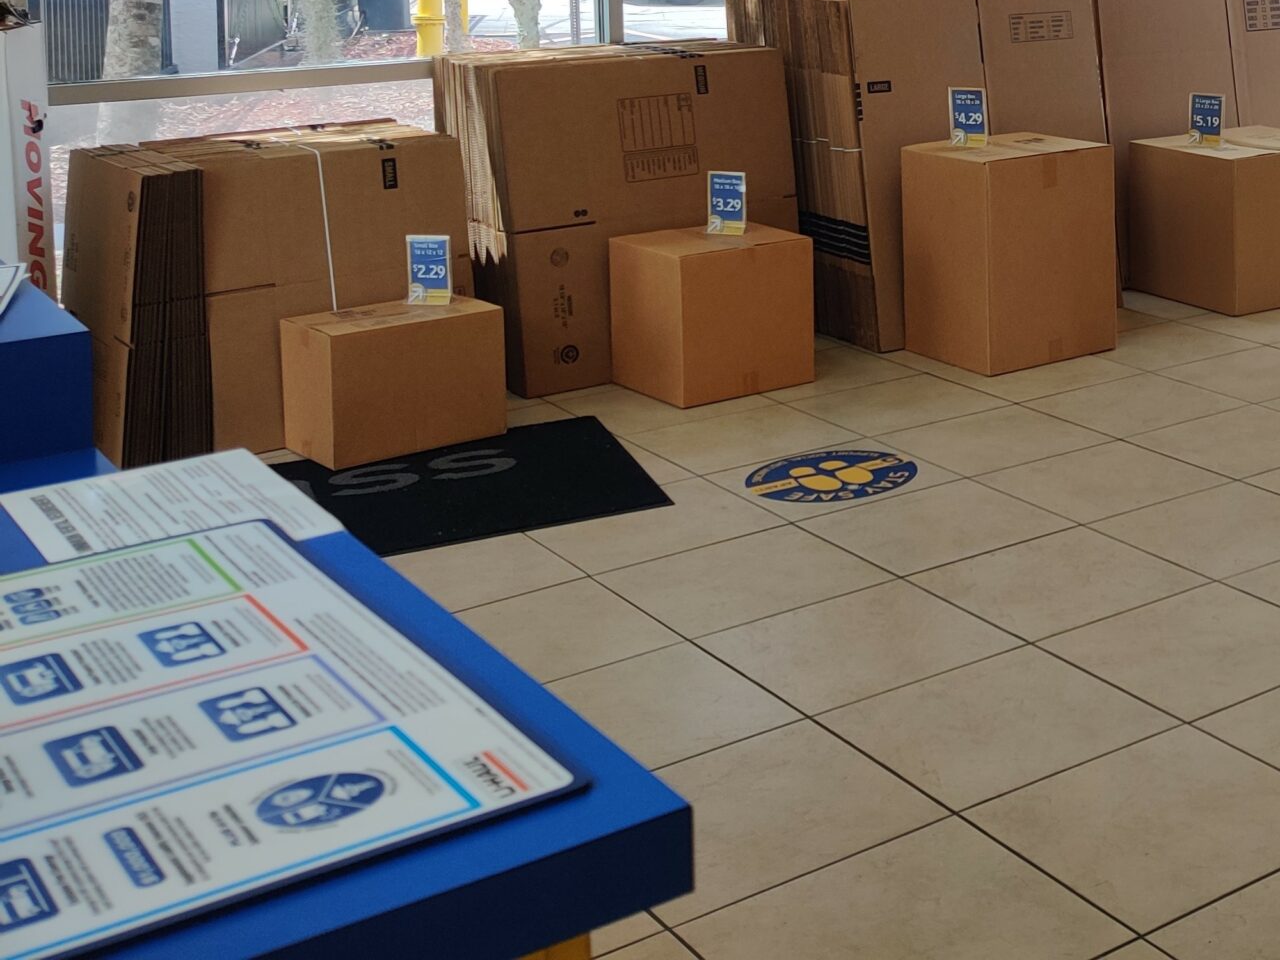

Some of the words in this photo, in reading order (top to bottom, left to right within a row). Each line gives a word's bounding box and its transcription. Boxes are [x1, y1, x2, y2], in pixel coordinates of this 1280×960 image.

[954, 112, 983, 125] $4.29
[1193, 114, 1220, 128] $5.19
[384, 161, 395, 187] SMALL
[712, 197, 742, 211] $3.29
[412, 264, 446, 279] $2.29
[865, 471, 909, 495] STAY
[784, 491, 855, 502] SAFE
